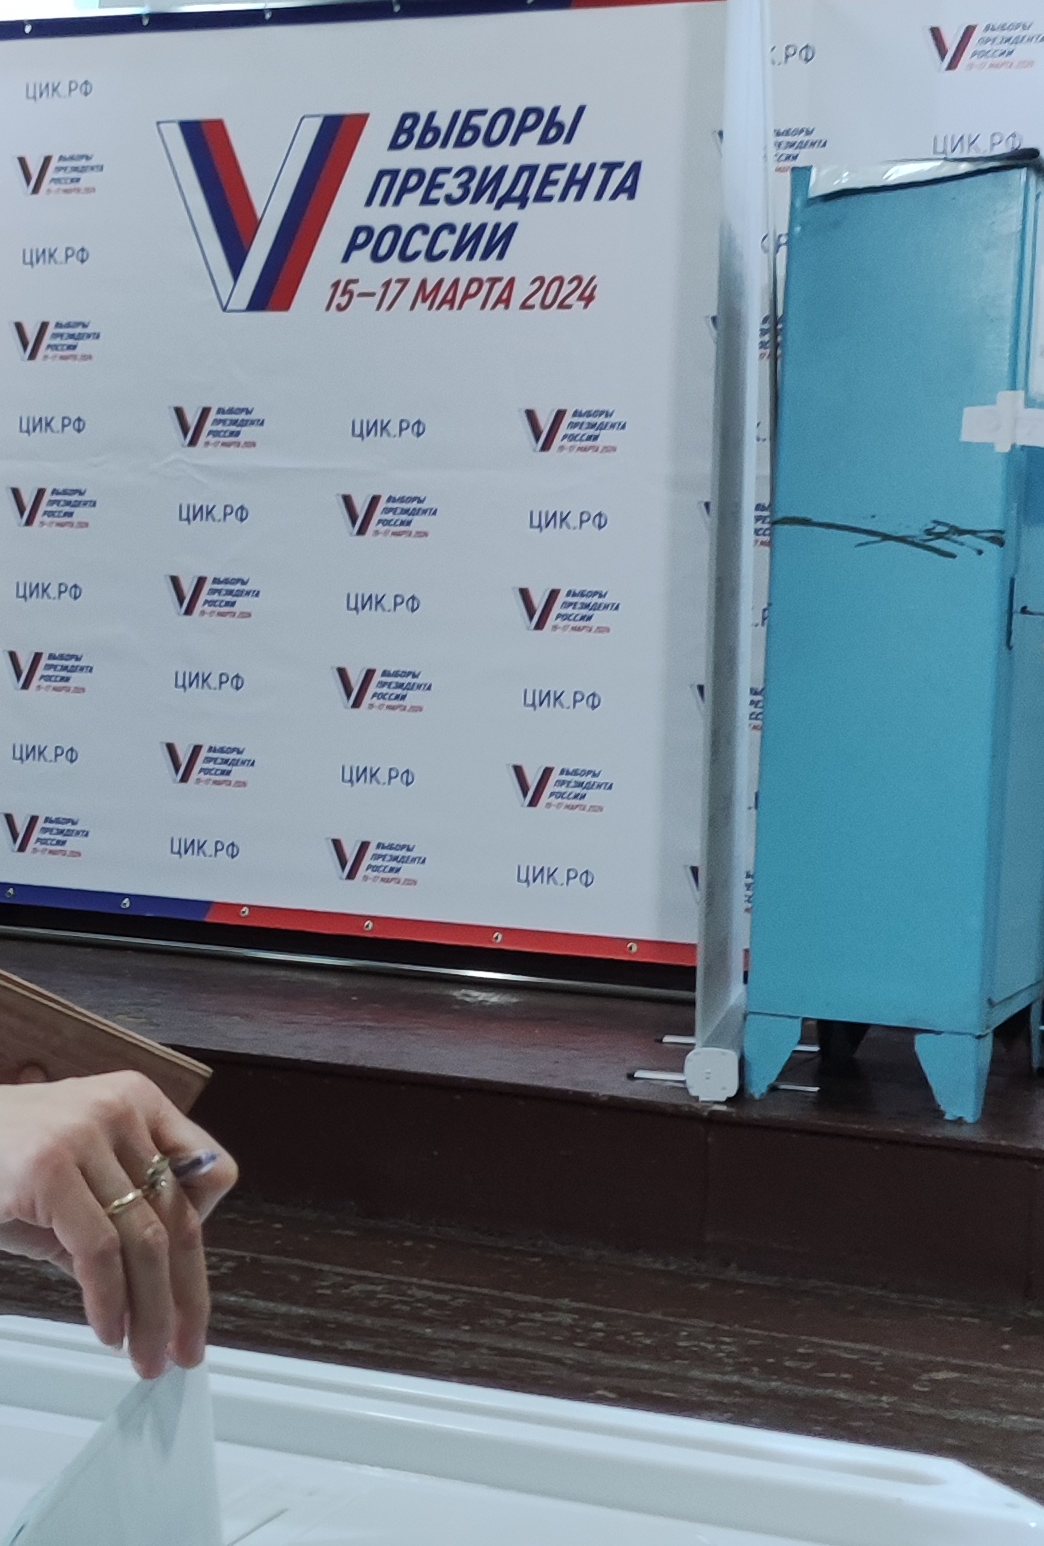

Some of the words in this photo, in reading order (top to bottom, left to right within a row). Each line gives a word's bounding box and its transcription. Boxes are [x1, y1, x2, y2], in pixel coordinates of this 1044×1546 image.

[26, 80, 92, 102] ЦИК.РФ
[387, 104, 587, 152] ВЫБОРЫ
[364, 160, 643, 210] ПРЕЗИДЕНТА
[341, 221, 519, 264] РОССИИ
[23, 246, 89, 268] ЦИК.РФ
[409, 275, 515, 312] МАРТА
[519, 274, 599, 310] 2024
[572, 409, 614, 418] ВЫБОРЫ
[19, 416, 86, 436] ЦИК.РФ
[352, 418, 425, 441] ЦИК.РФ
[567, 421, 626, 431] ПРЕЗИДЕНТА
[561, 433, 600, 442] РОССИИ
[179, 504, 249, 525] ЦИК.РФ
[530, 510, 607, 533] ЦИК.РФ
[16, 582, 82, 602] ЦИК.РФ
[565, 589, 608, 599] ВЫБОРЫ
[347, 593, 420, 615] ЦИК.РФ
[560, 601, 620, 611] ПРЕЗИДЕНТА
[555, 613, 594, 622] РОССИИ
[175, 671, 244, 692] ЦИК.РФ
[524, 689, 601, 711] ЦИК.РФ
[12, 743, 78, 764] ЦИК.РФ
[342, 765, 414, 787] ЦИК.РФ
[559, 768, 601, 778] ВЫБОРЫ
[548, 791, 586, 800] РОССИИ
[554, 780, 613, 790] ПРЕЗИДЕНТА
[171, 837, 239, 859] ЦИК.РФ
[517, 865, 594, 888] ЦИК.РФ
